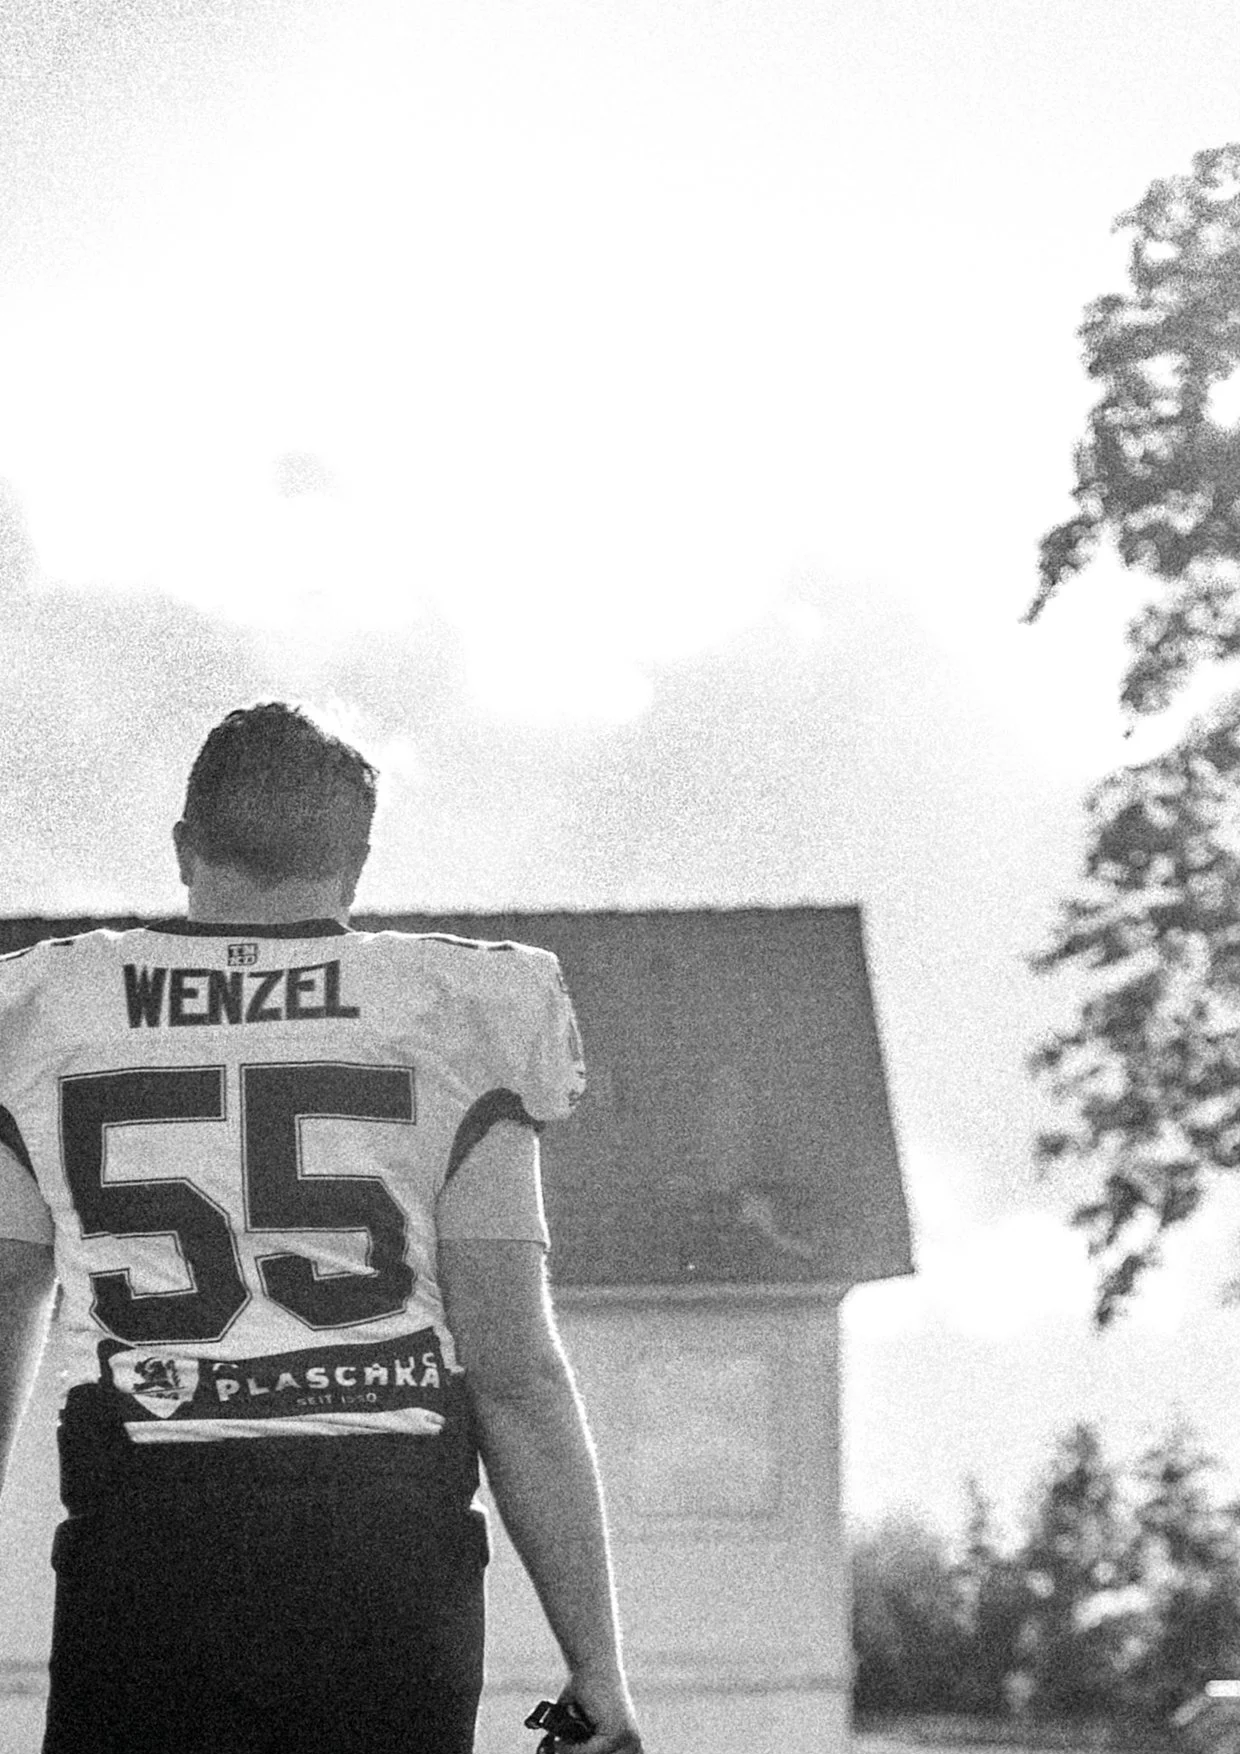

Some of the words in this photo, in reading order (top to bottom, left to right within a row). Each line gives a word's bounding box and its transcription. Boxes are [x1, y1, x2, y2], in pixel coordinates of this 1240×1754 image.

[123, 959, 360, 1028] WENZEL
[59, 1060, 416, 1346] 55
[215, 1364, 441, 1402] PLASCHKA
